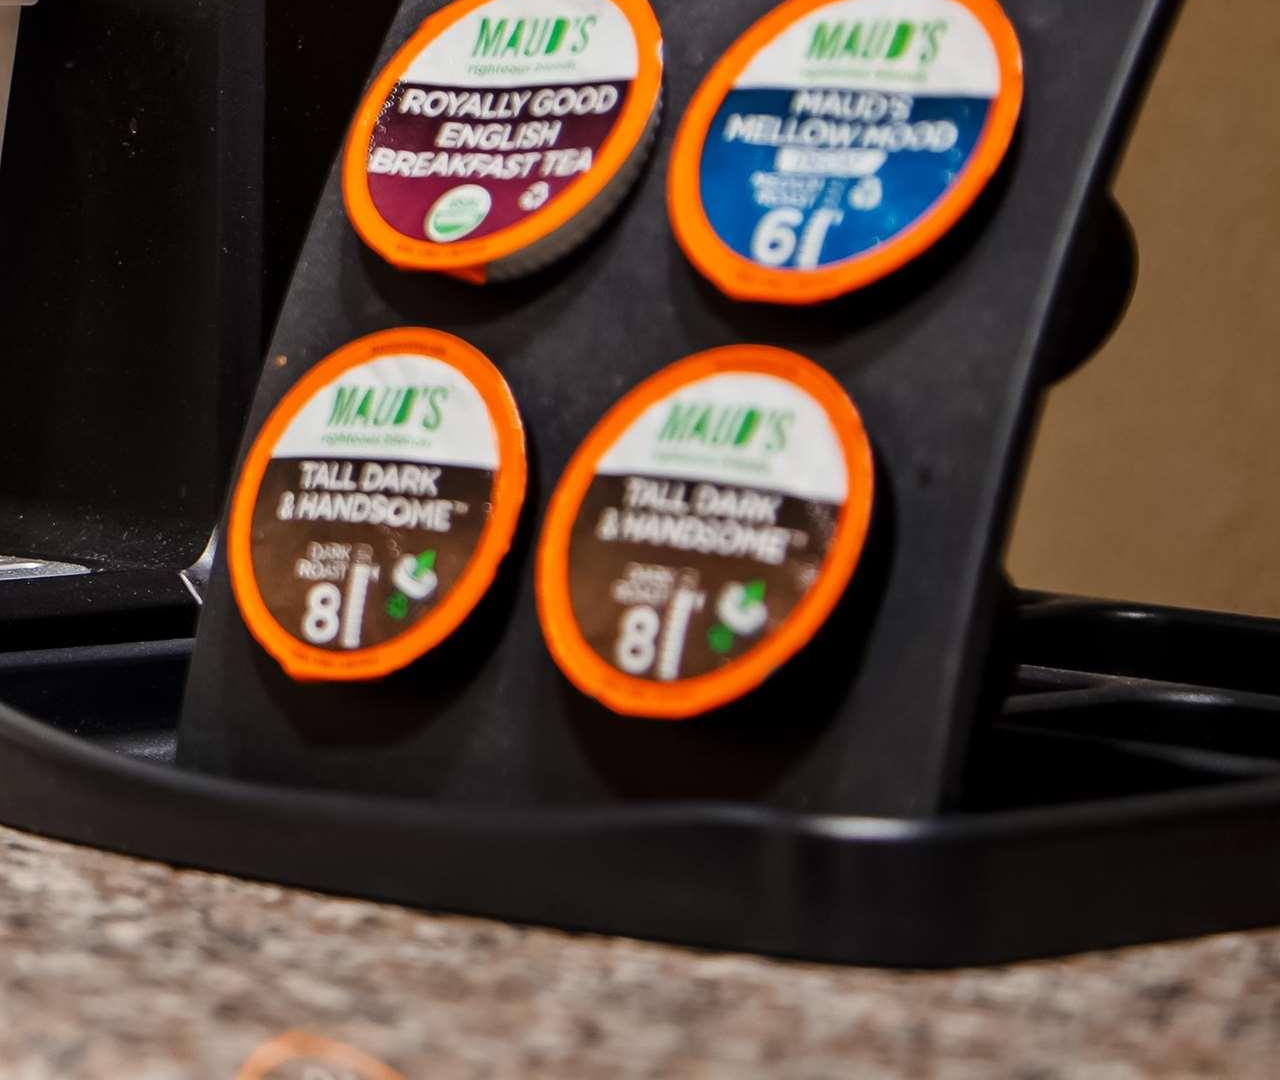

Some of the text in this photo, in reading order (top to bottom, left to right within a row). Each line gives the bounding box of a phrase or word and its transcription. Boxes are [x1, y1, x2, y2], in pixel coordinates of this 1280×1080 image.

[472, 15, 597, 58] MAUD'S
[806, 19, 948, 66] MAUD'S
[399, 84, 619, 118] ROYALLY GOOD
[434, 120, 563, 150] ENGLISH
[723, 113, 959, 153] MELLOW MOOD
[368, 146, 593, 180] BREAKFAST TEA
[751, 207, 803, 266] 6
[327, 385, 449, 433] MAUD'S
[656, 402, 795, 451] MAUD'S
[299, 460, 441, 497] TALL DARK
[277, 490, 295, 520] &
[623, 476, 783, 525] TALL DARK
[295, 558, 347, 580] ROAST
[306, 541, 352, 561] DARK
[301, 582, 341, 644] 8
[614, 605, 660, 674] 8
